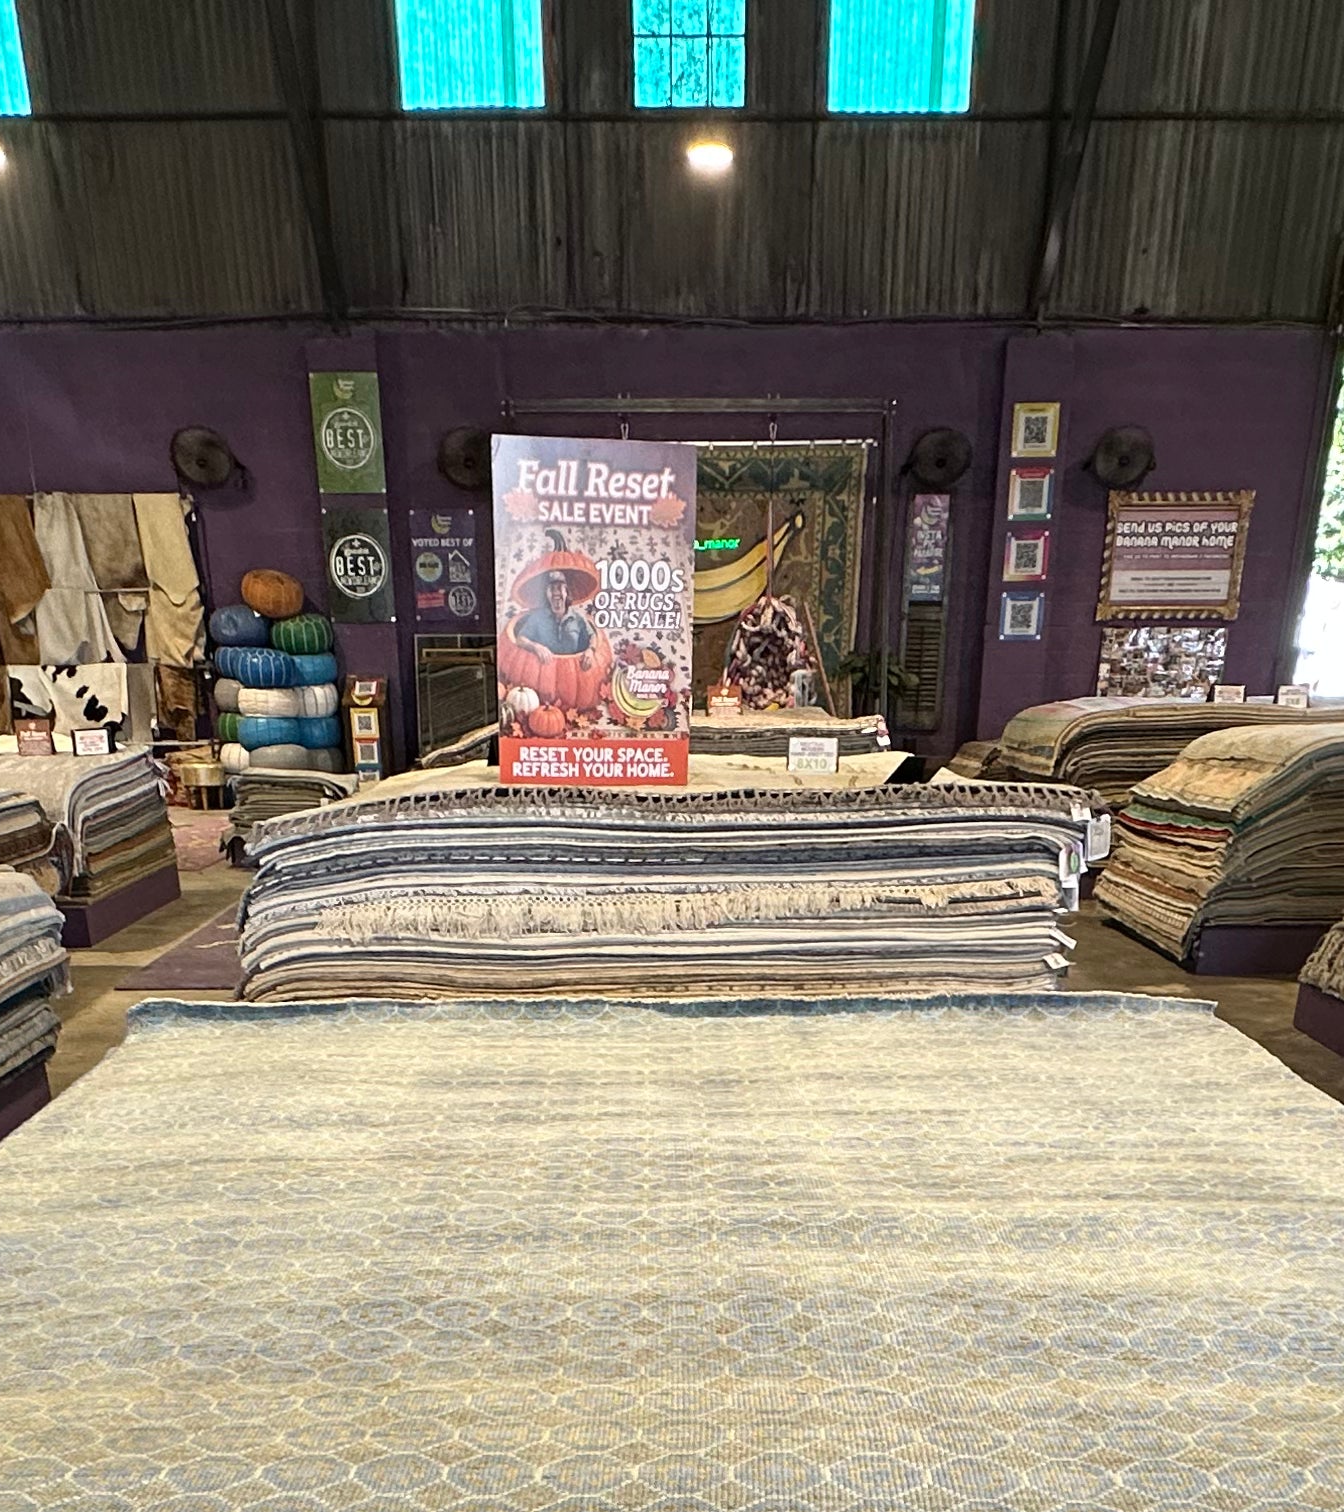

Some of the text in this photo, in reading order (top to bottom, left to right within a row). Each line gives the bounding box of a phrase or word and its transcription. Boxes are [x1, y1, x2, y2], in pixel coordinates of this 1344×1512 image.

[325, 429, 364, 448] BEST
[517, 459, 676, 499] Fall Reset
[538, 501, 652, 525] SALE EVENT
[411, 538, 439, 547] VOTED
[440, 538, 460, 547] BEST
[336, 556, 375, 576] BEST
[595, 559, 685, 592] 1000s
[595, 591, 676, 611] OF RUGS
[595, 610, 681, 629] ON SALE!
[627, 665, 669, 680] Banana
[629, 679, 667, 693] Manor
[519, 747, 668, 762] RESET YOUR SPACE.
[797, 758, 828, 769] 8X10
[512, 763, 675, 777] REFRESH YOUR HOME.
